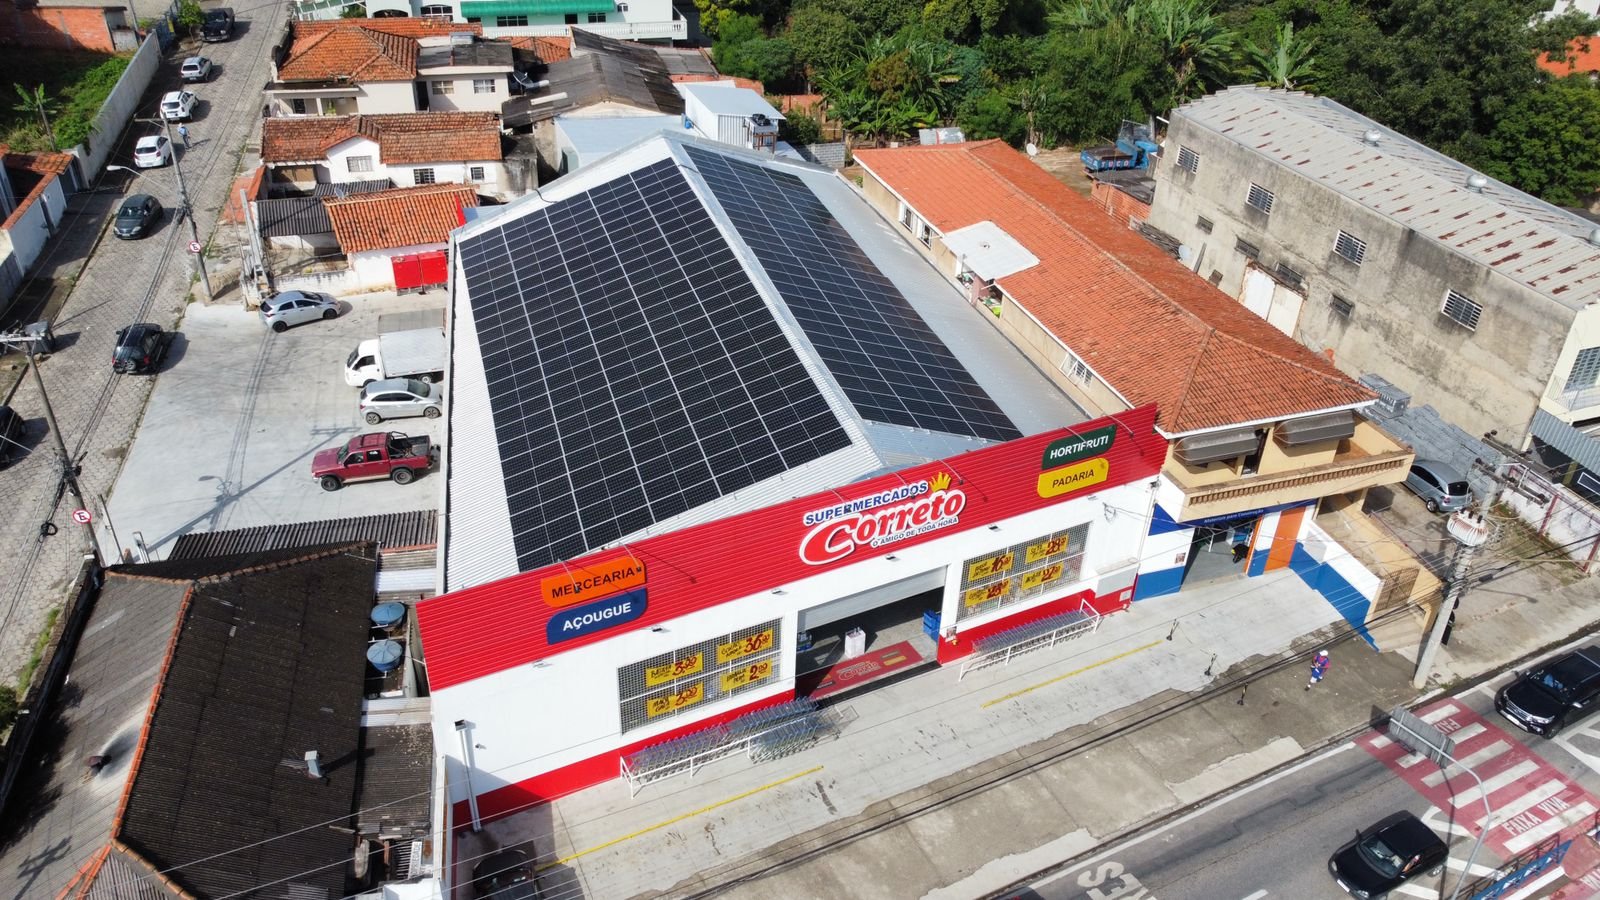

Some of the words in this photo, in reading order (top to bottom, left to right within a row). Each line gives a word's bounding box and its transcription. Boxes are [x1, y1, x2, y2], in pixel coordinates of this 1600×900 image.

[1049, 435, 1109, 460] HORTIFRUTI
[1052, 469, 1095, 488] PADARIA
[805, 482, 928, 525] SUPERMERCADOS
[802, 492, 964, 563] Correto
[881, 533, 905, 545] AMIGO
[906, 529, 916, 537] DE
[918, 524, 937, 534] TODA
[938, 517, 959, 528] HORA
[552, 567, 635, 599] MERCEARIA
[563, 602, 632, 632] AÇOUGUE
[1501, 811, 1542, 836] FAIXA
[1536, 796, 1570, 816] VIVA
